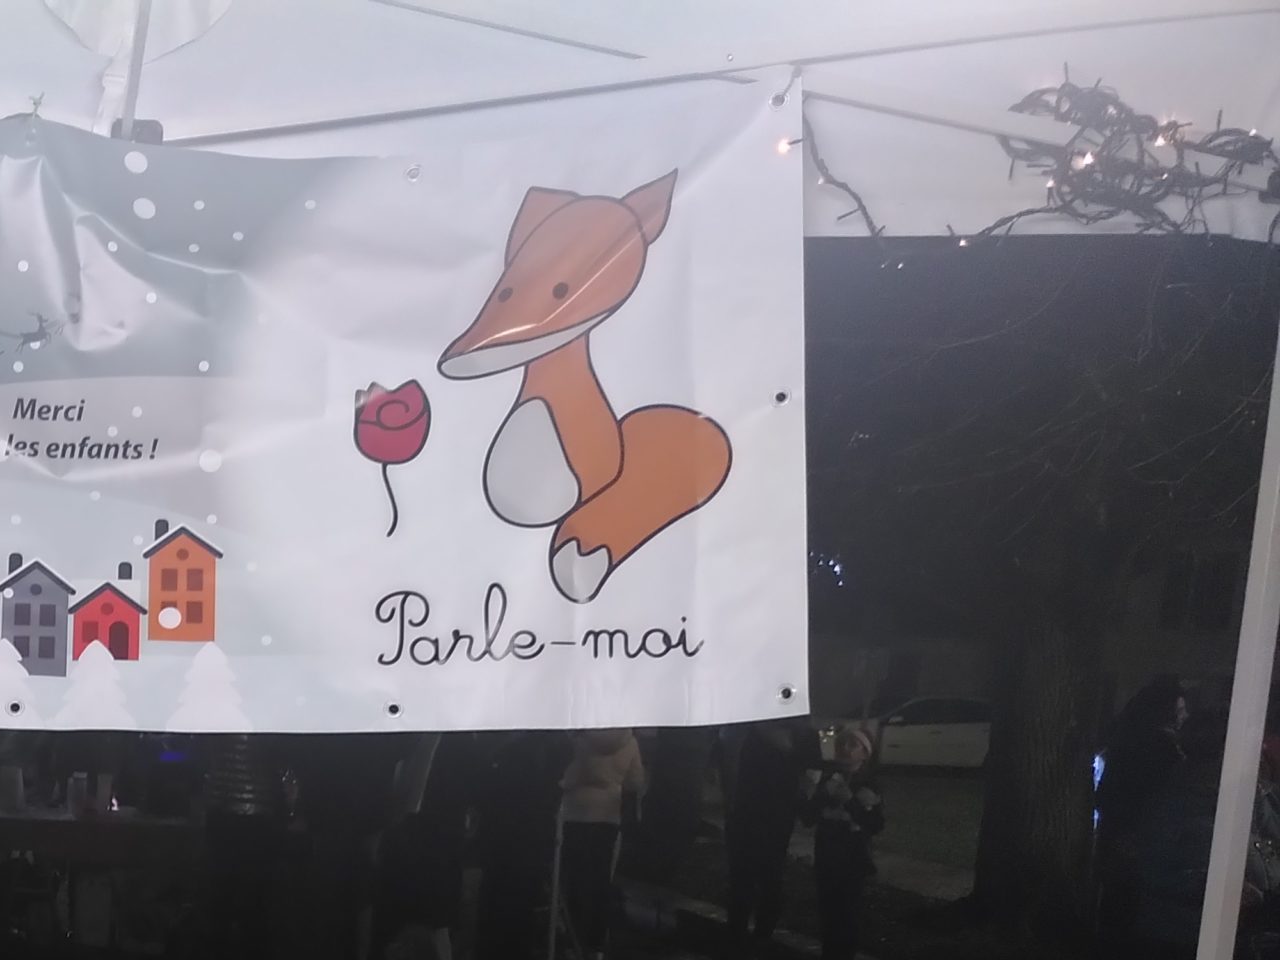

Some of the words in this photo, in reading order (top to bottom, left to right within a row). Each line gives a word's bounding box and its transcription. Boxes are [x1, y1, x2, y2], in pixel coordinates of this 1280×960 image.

[12, 398, 85, 422] Merci
[4, 433, 39, 457] les
[45, 436, 144, 460] enfants
[375, 582, 705, 666] Parle-moi
